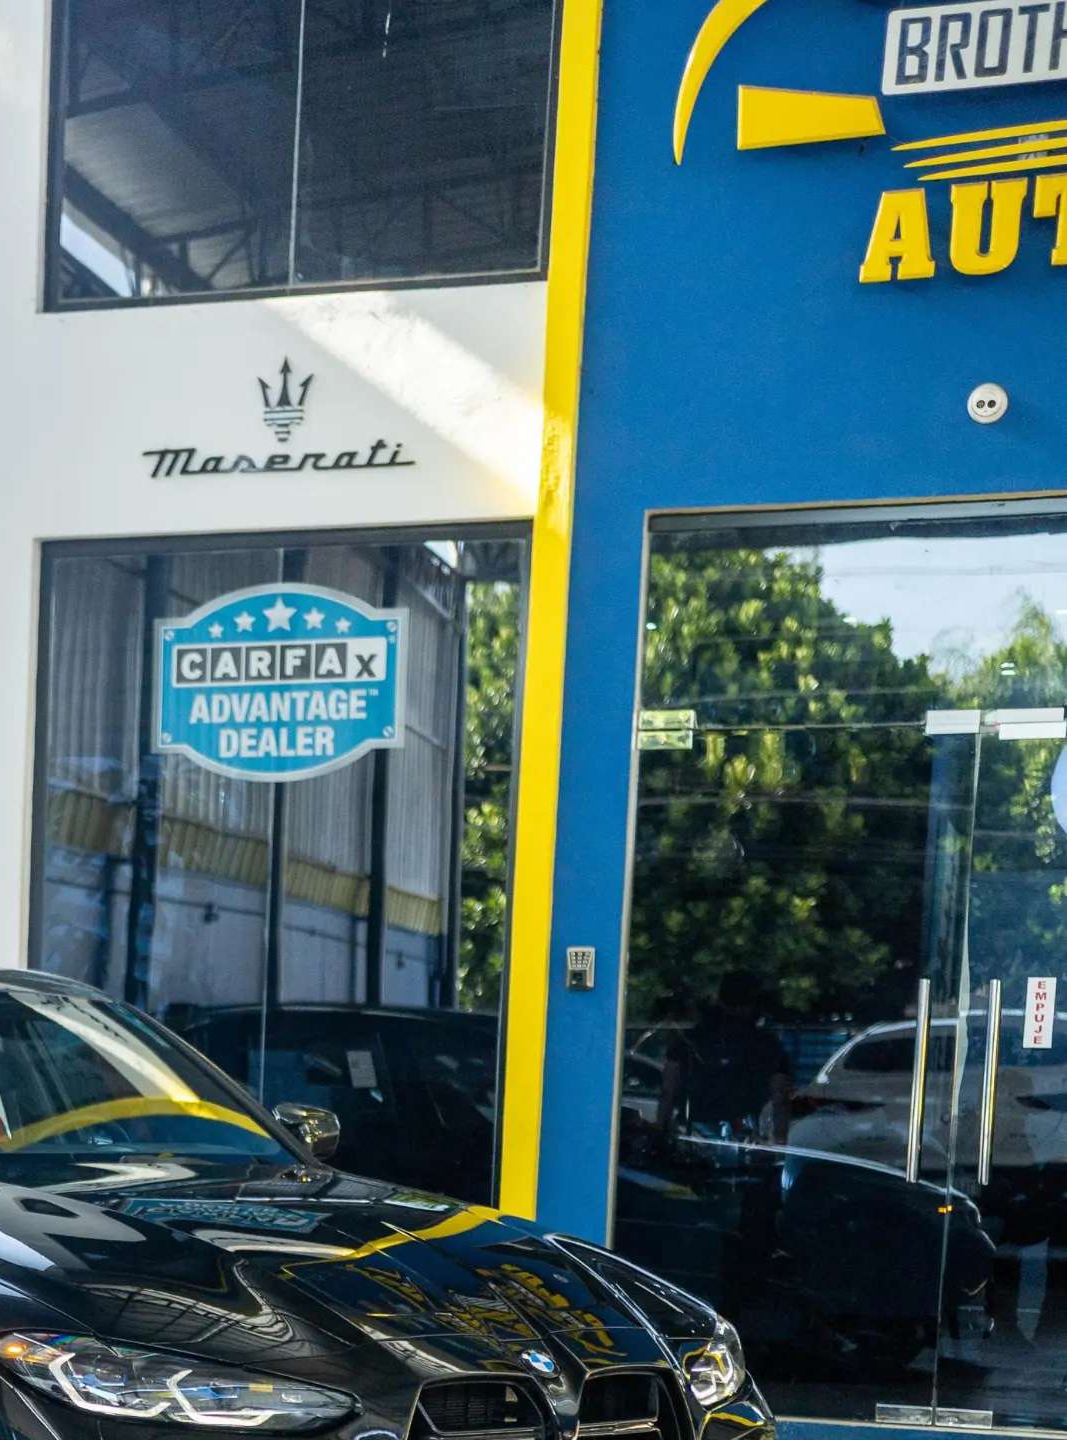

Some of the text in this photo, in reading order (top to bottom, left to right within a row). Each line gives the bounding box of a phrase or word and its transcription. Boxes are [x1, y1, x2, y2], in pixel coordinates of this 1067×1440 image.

[143, 439, 415, 478] Maserati
[179, 645, 377, 682] CARFAX
[219, 727, 334, 758] DEALER
[1033, 981, 1047, 1044] EMPUJE
